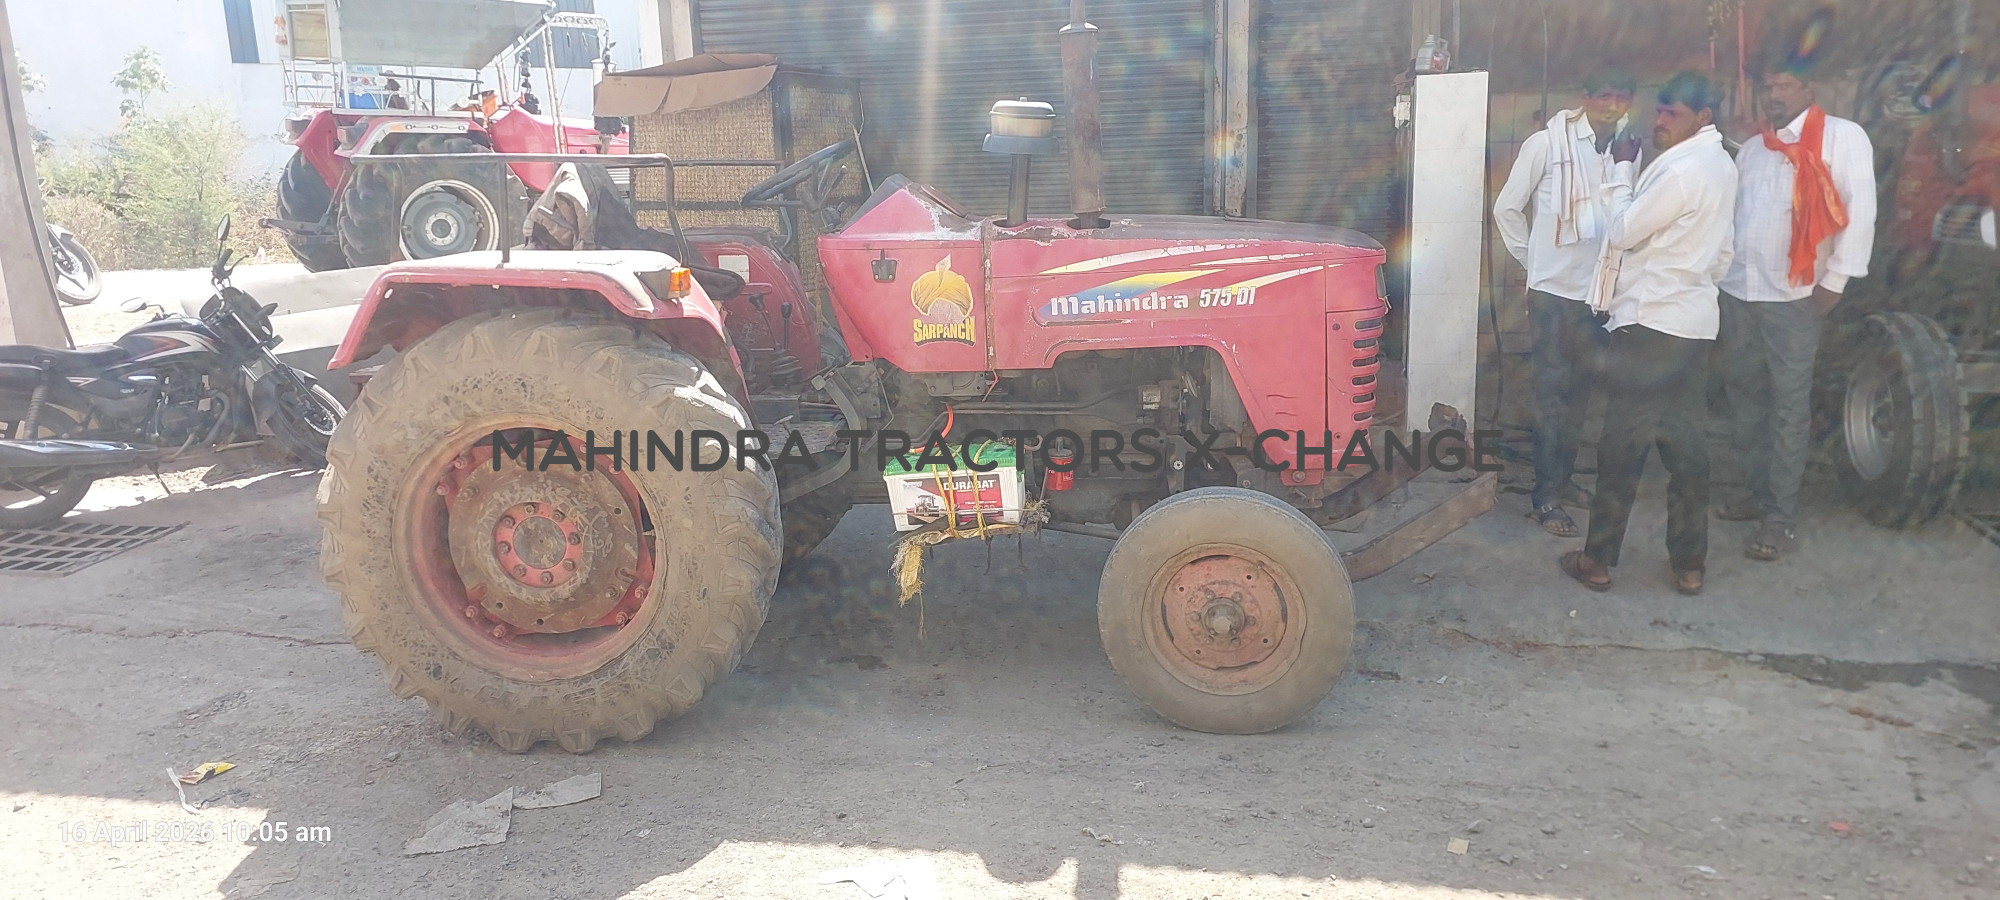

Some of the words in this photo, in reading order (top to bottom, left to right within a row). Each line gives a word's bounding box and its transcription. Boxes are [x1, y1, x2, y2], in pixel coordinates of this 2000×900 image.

[1050, 291, 1189, 315] Mahindra
[1199, 287, 1232, 307] 575
[1236, 286, 1256, 305] DI
[913, 317, 975, 343] SARPANCH
